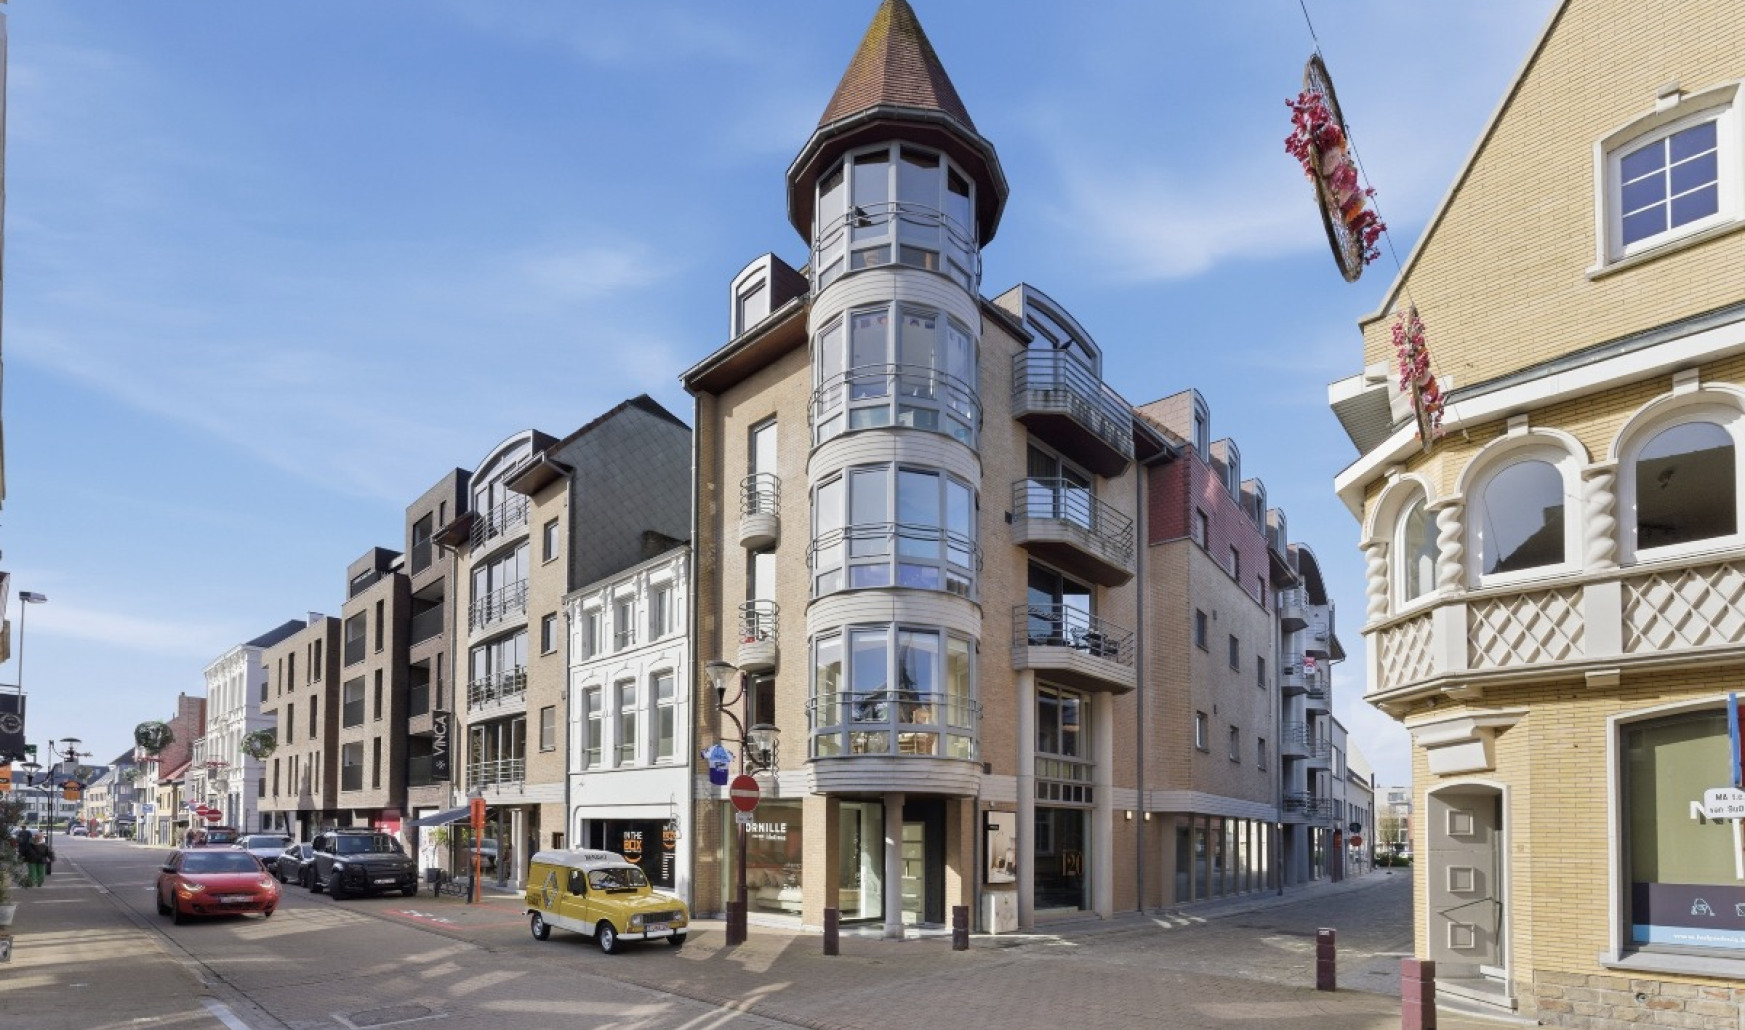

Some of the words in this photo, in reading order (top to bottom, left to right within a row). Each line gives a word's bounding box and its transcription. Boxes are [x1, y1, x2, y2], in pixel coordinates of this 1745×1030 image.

[433, 715, 447, 757] VINCA
[746, 823, 787, 832] ORNILLE
[624, 832, 631, 840] IN
[631, 832, 642, 840] THE
[624, 840, 641, 850] BOX
